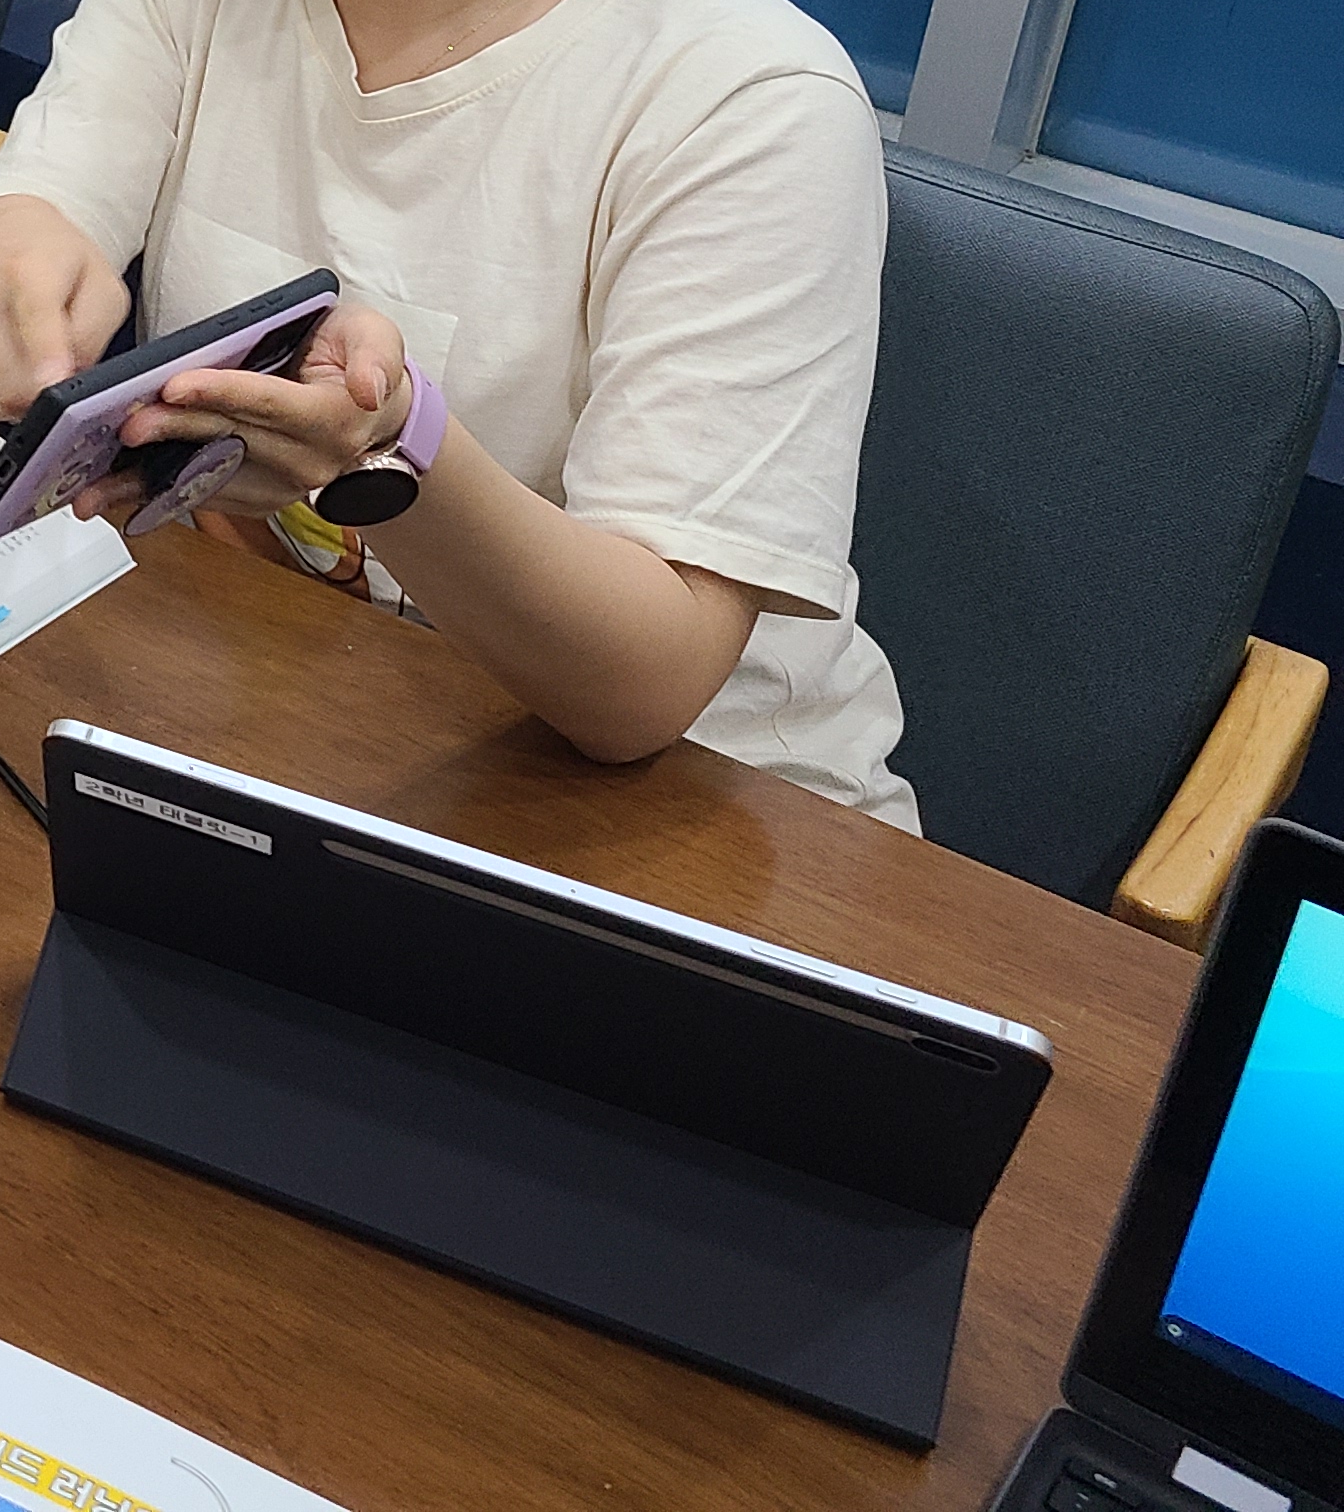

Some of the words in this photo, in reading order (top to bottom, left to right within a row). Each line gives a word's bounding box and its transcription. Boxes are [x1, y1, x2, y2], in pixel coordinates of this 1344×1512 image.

[84, 780, 145, 808] 2학년
[159, 803, 258, 846] 태블릿-1
[49, 1468, 160, 1512] 러닝
